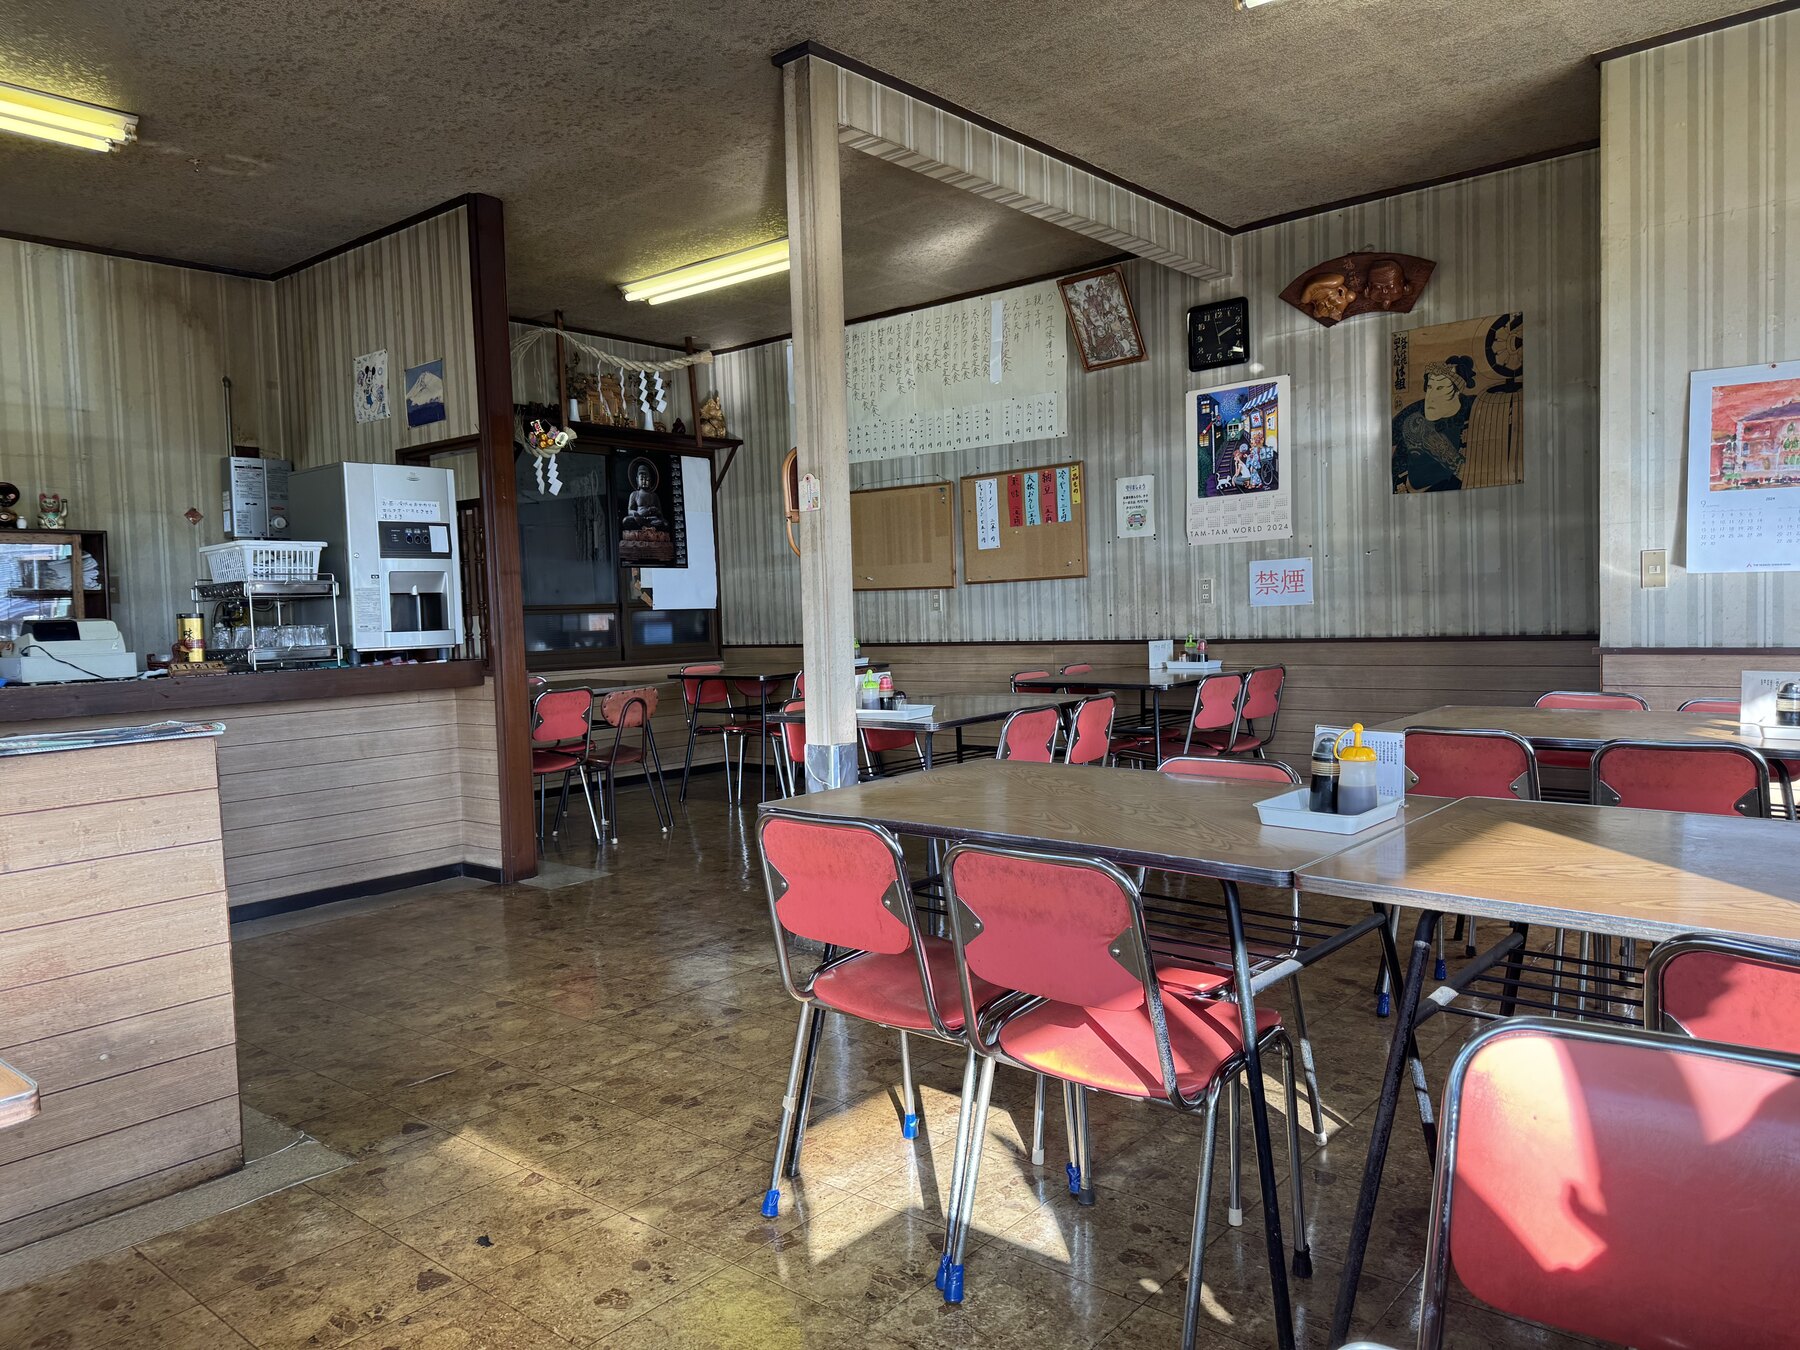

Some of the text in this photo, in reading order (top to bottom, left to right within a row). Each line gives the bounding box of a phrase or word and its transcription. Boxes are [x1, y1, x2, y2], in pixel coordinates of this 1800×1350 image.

[1013, 299, 1022, 342] えび天丼
[1024, 298, 1033, 332] 玉子丼
[1033, 294, 1043, 329] 親子丼
[923, 319, 933, 372] とんかつ定食
[932, 316, 942, 370] コロッケ定食
[1190, 523, 1289, 538] TAM-TAM WORLD 2024
[1255, 568, 1306, 595] 禁煙
